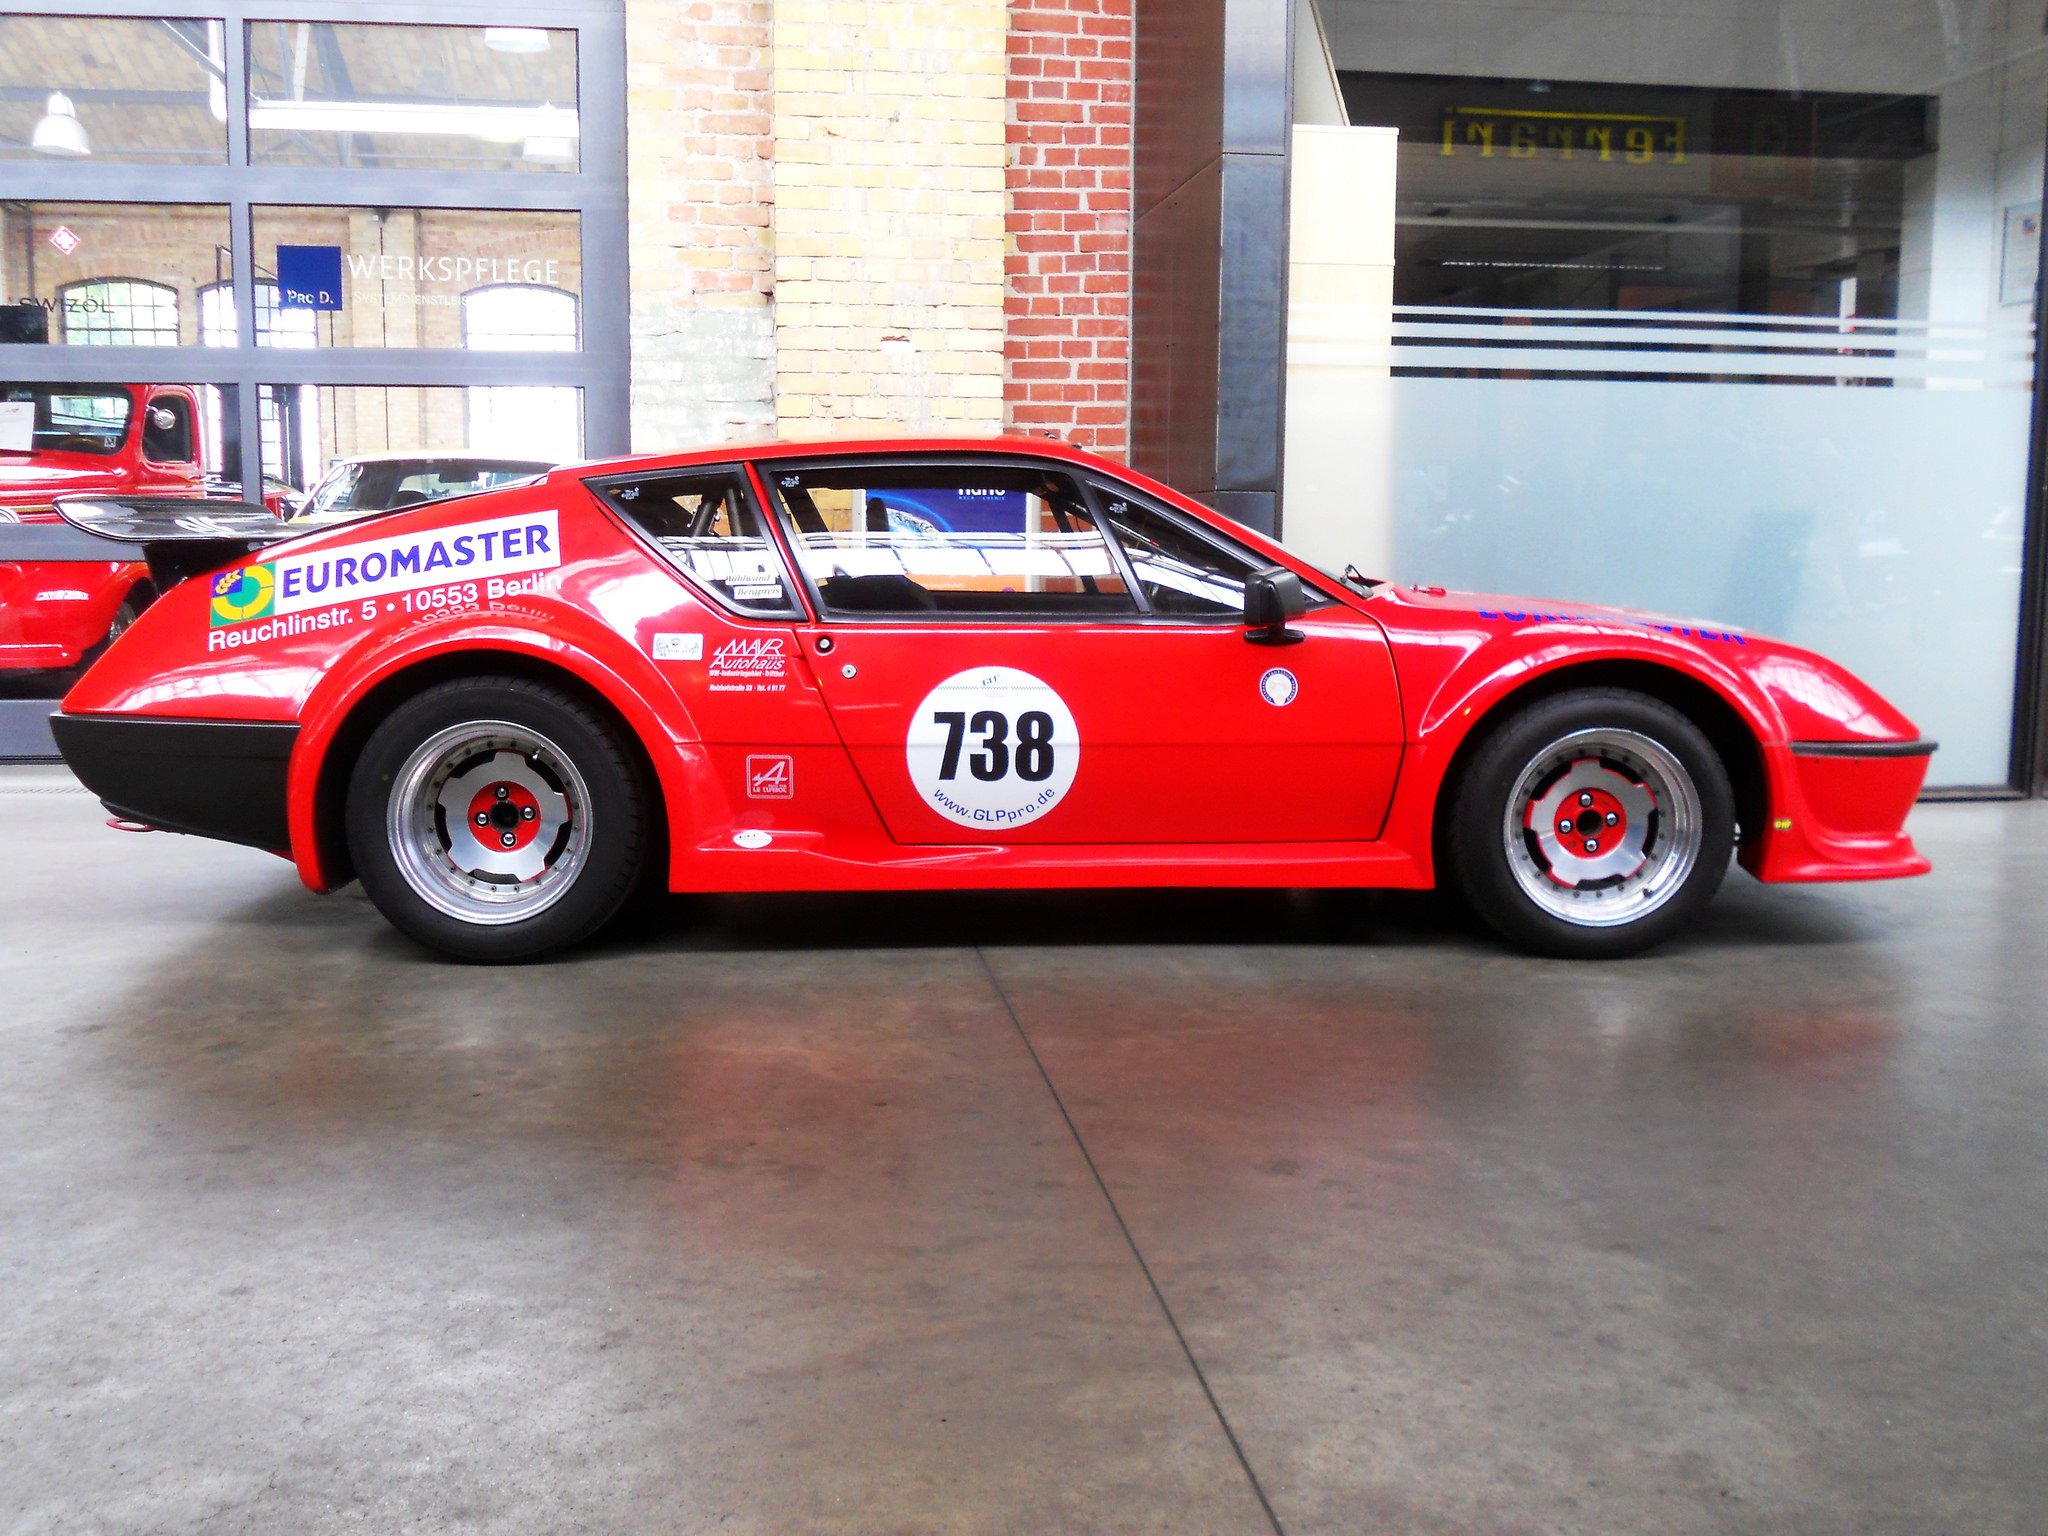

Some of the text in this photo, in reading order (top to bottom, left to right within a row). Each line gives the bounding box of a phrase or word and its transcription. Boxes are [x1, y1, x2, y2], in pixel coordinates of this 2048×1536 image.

[346, 254, 559, 284] WERKSPFLEGE
[320, 291, 336, 305] D.
[282, 524, 552, 598] EUROMASTER
[208, 608, 353, 652] Reuchlinstr.
[361, 600, 377, 621] 5
[402, 583, 479, 613] 10553
[487, 569, 562, 599] Berlin
[709, 655, 785, 670] Autohaus
[933, 710, 1055, 782] 738
[934, 788, 1055, 823] www.GLPpro.de
